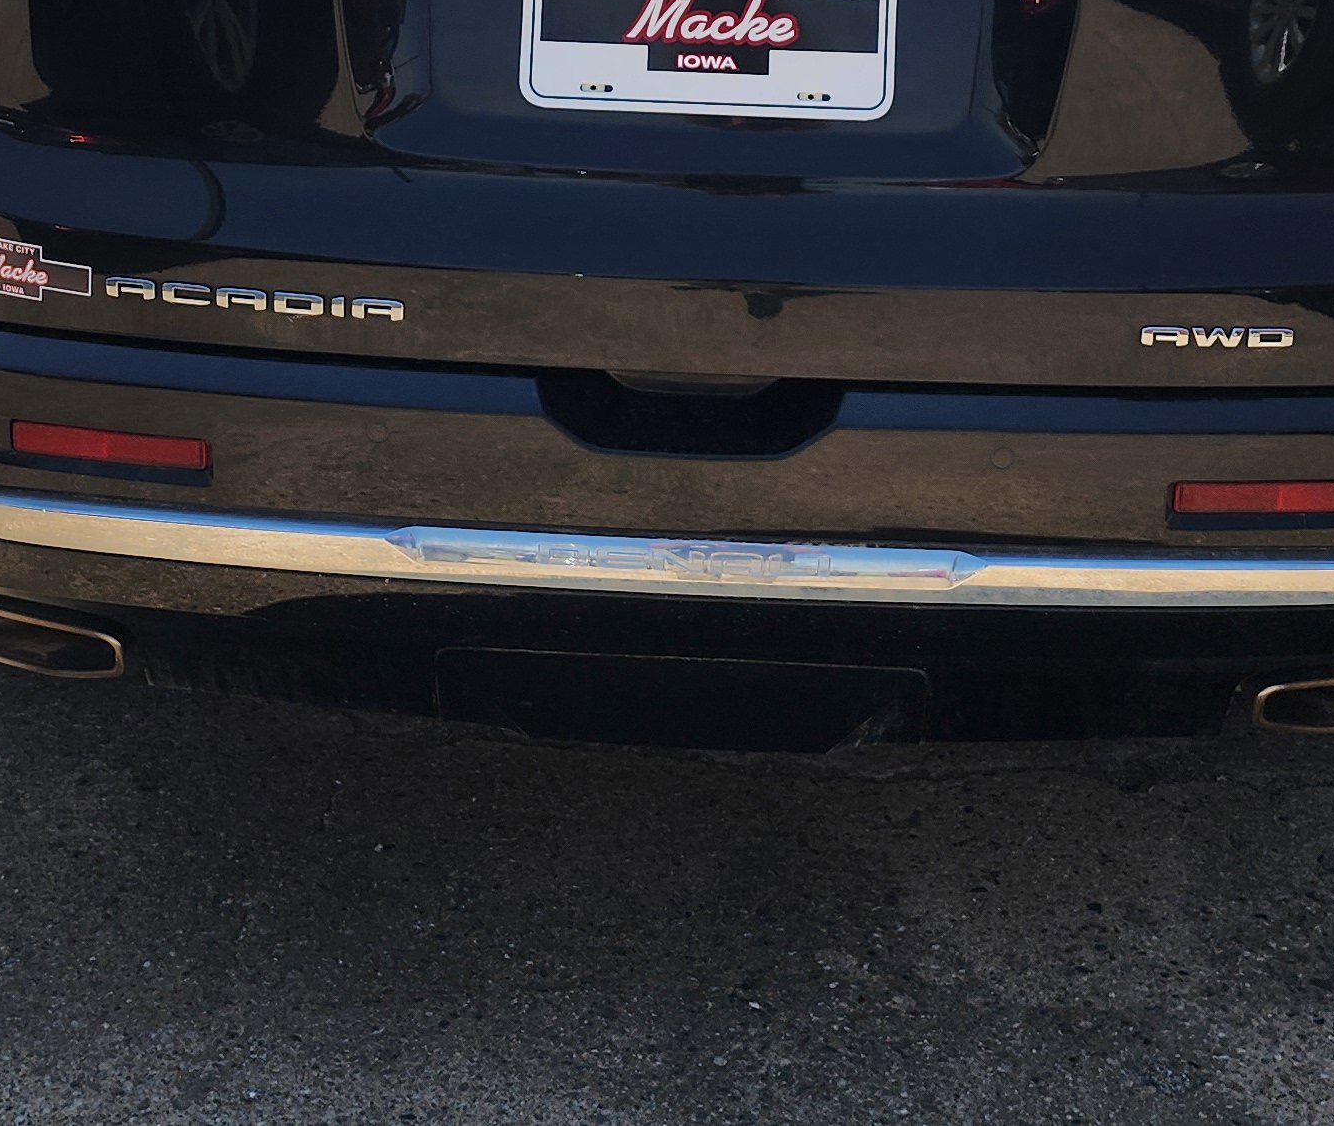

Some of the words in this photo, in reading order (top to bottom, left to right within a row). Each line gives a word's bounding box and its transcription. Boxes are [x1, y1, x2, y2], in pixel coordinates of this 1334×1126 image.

[677, 53, 738, 71] IOWA
[15, 245, 36, 256] CITY
[2, 283, 25, 295] IOWA
[105, 276, 405, 321] ACADIA
[1140, 326, 1295, 348] AWD
[537, 542, 831, 580] DENALI
